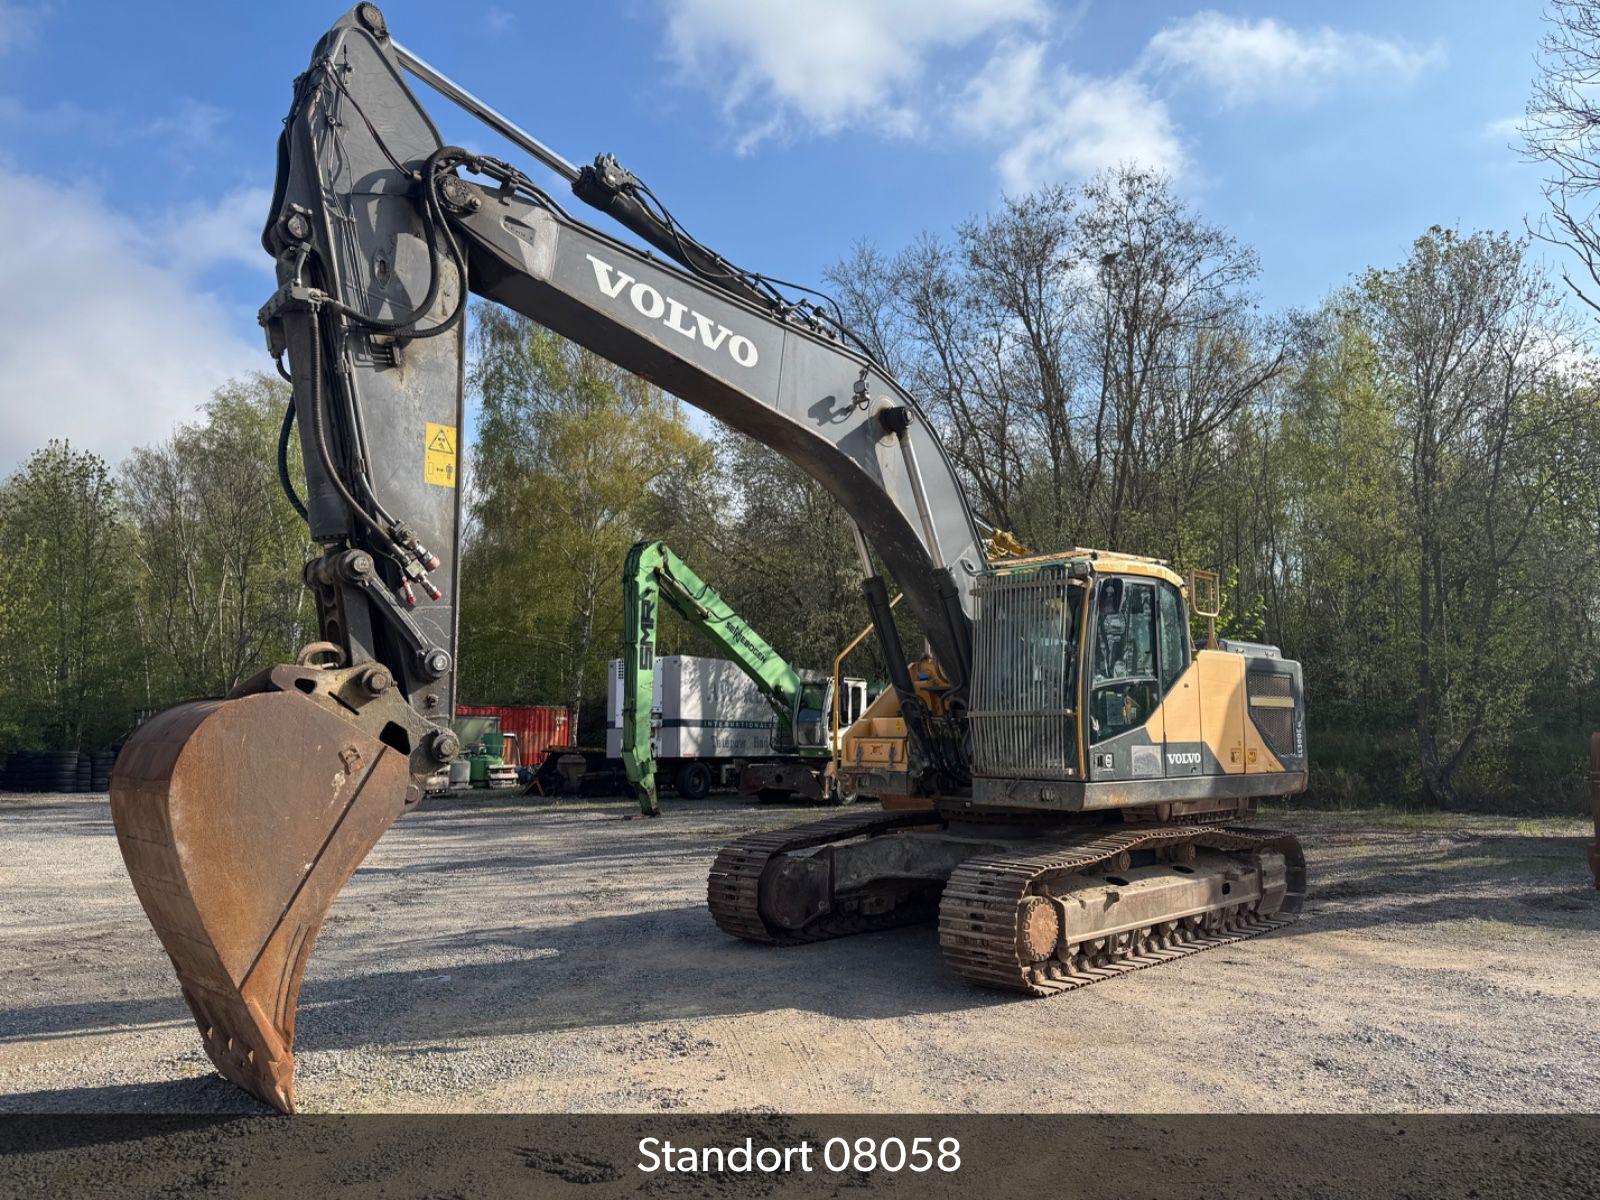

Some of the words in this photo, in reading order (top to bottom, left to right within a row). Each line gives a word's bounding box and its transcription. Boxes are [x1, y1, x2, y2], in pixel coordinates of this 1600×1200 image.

[586, 253, 759, 368] VOLVO
[639, 599, 655, 671] SMR
[725, 621, 767, 664] SENNEBOGEN
[1167, 753, 1202, 765] VOLVO
